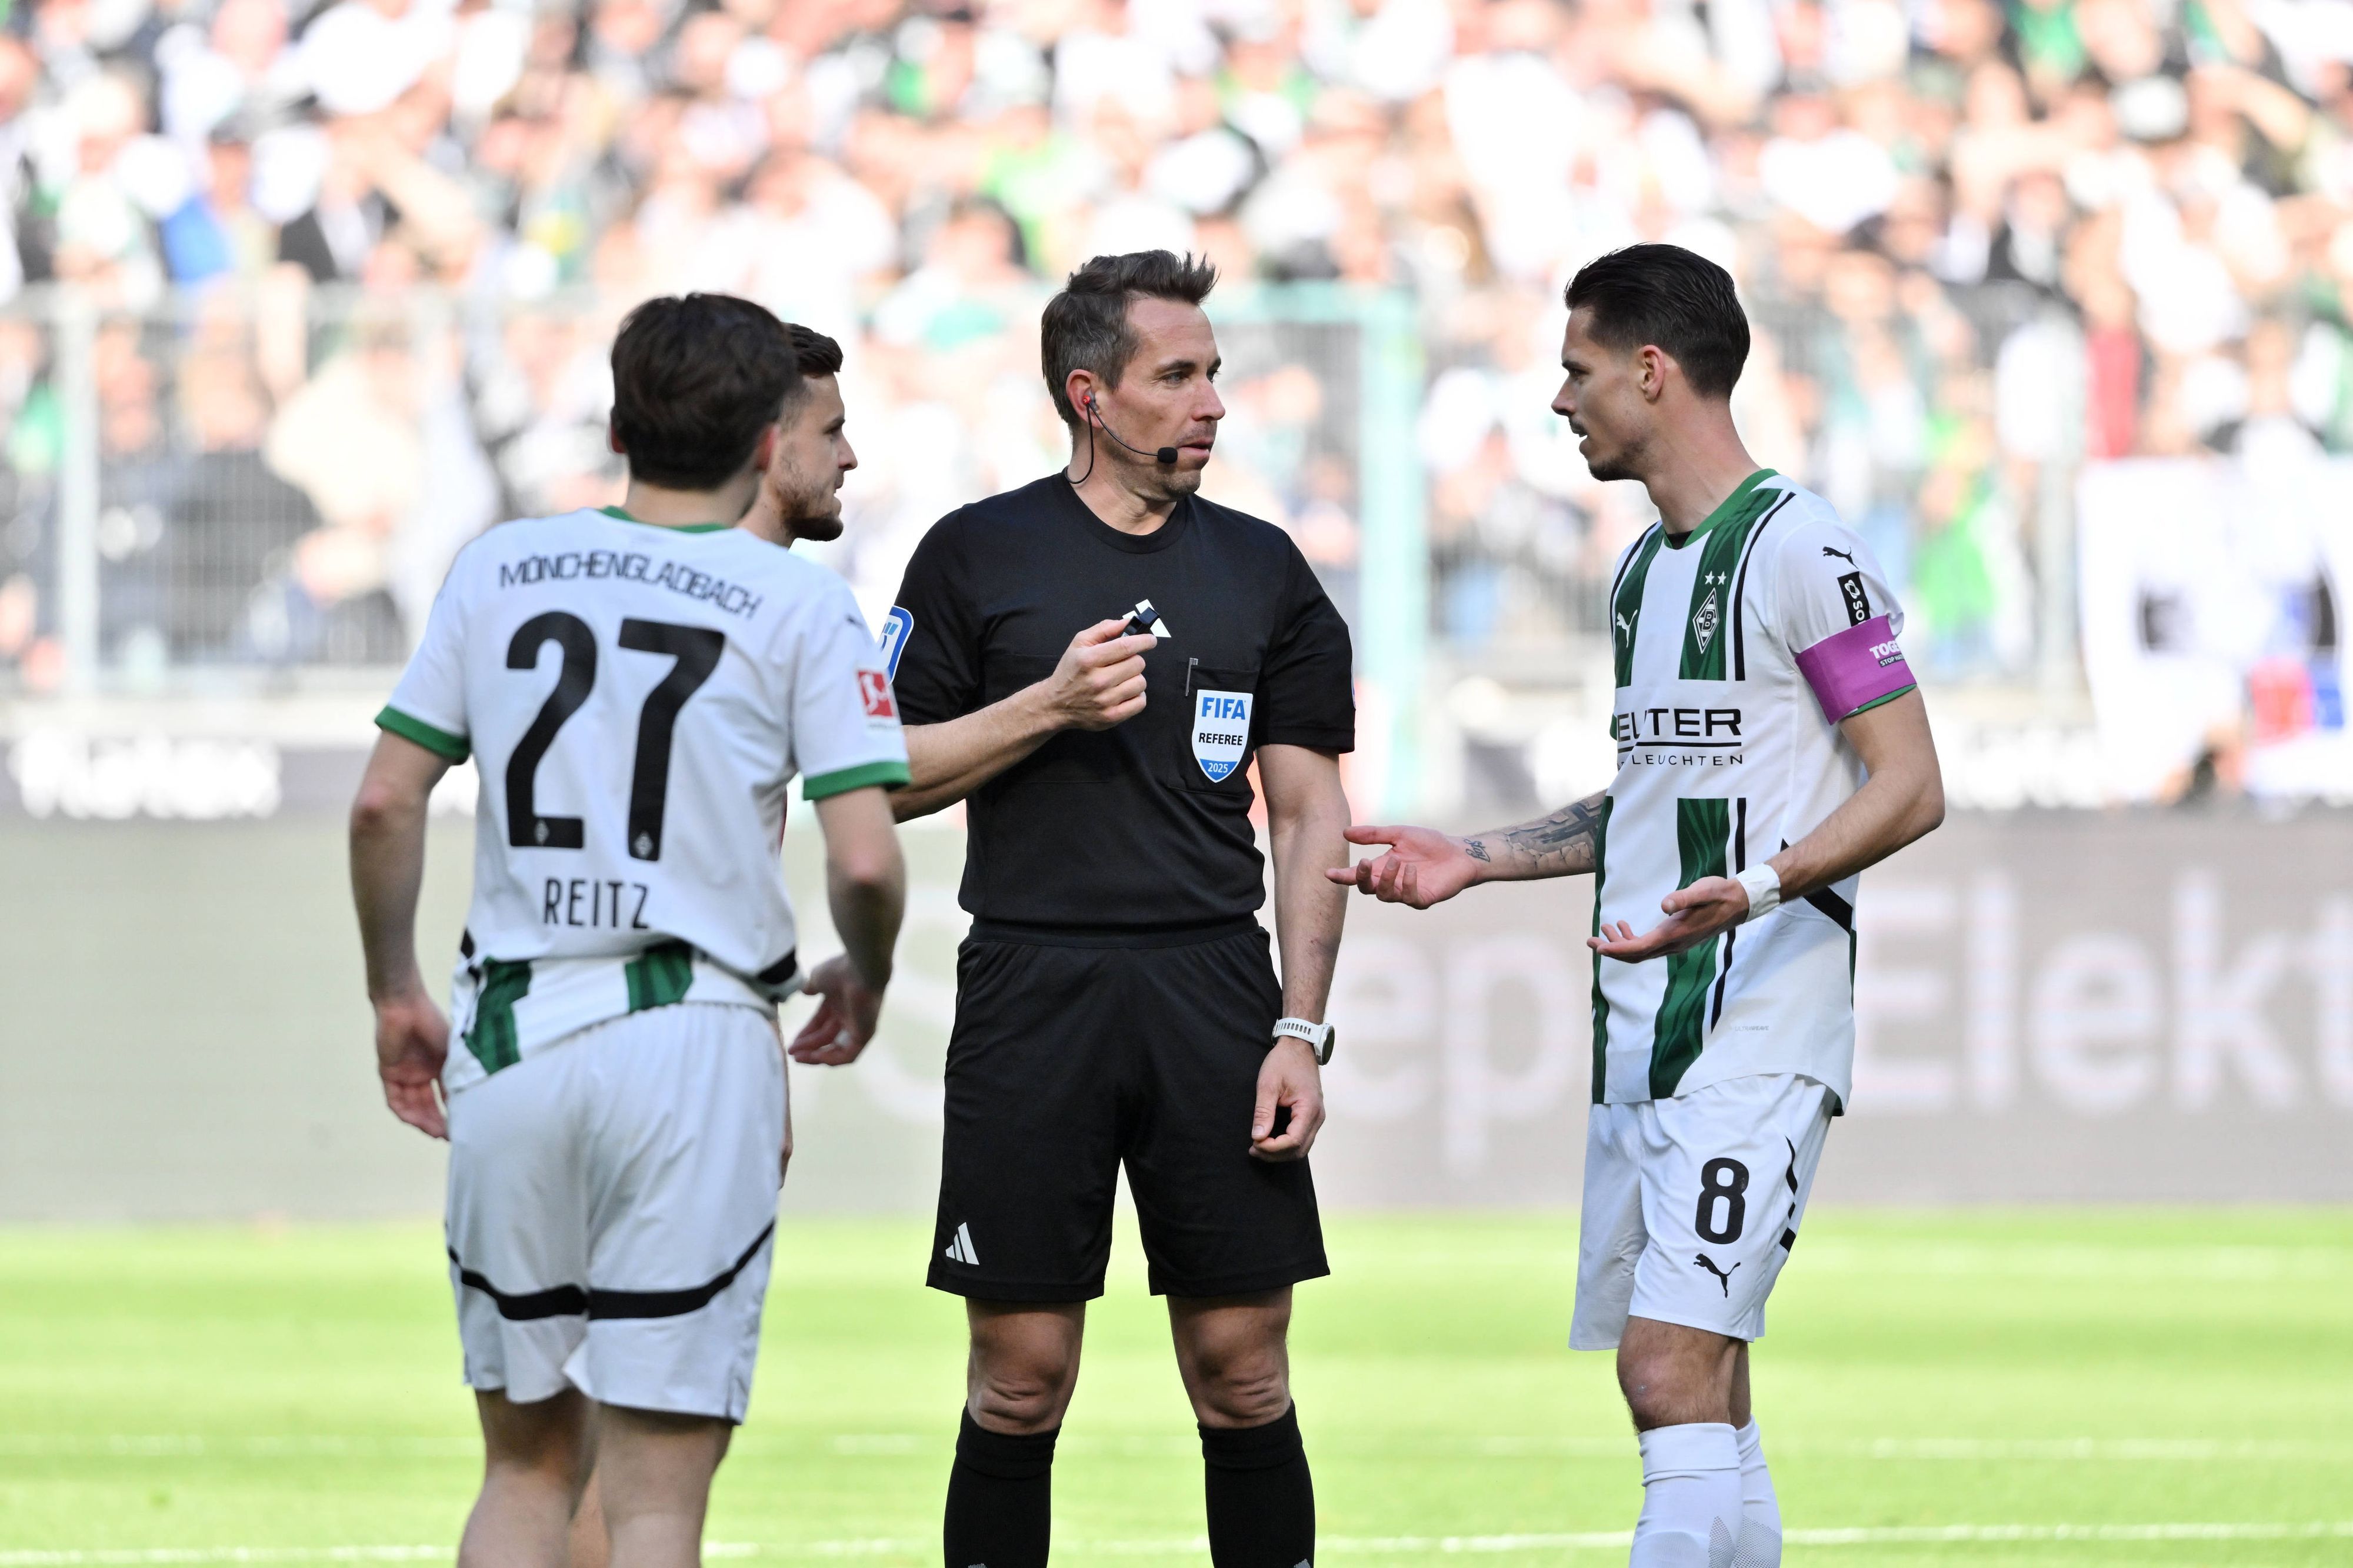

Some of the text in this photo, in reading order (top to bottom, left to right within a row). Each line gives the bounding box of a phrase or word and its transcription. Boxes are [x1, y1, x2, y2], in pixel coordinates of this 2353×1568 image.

[1880, 656, 1895, 666] STOP
[1201, 696, 1246, 720] FIFA
[506, 610, 725, 862] 27
[1198, 732, 1244, 746] REFEREE
[1208, 762, 1229, 773] 2025
[1632, 754, 1743, 766] LEUCHTEN
[544, 878, 650, 930] REITZ
[1695, 1157, 1749, 1245] 8
